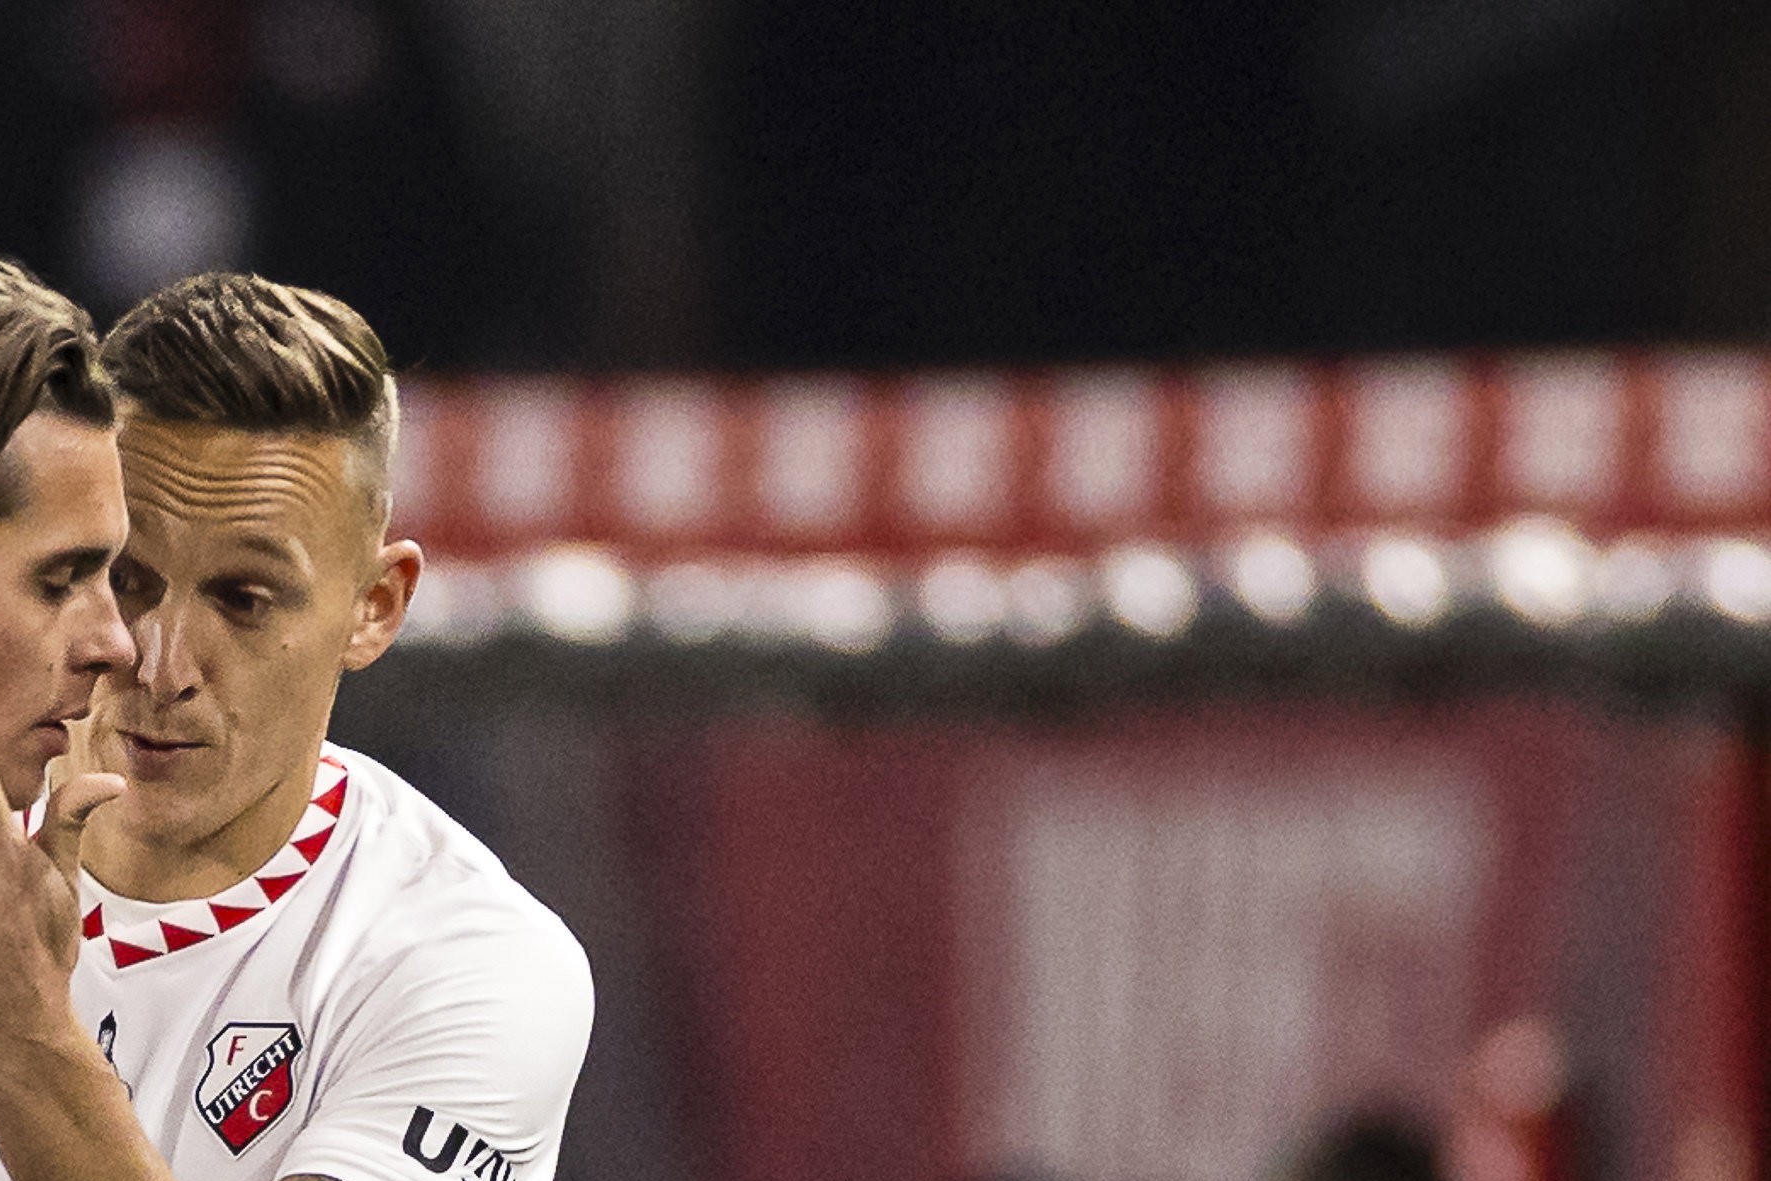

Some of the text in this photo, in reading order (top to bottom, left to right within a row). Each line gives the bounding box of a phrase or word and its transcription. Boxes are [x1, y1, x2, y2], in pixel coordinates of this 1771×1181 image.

[227, 1035, 247, 1066] F
[206, 1032, 295, 1125] UTRECHT
[249, 1089, 273, 1121] C
